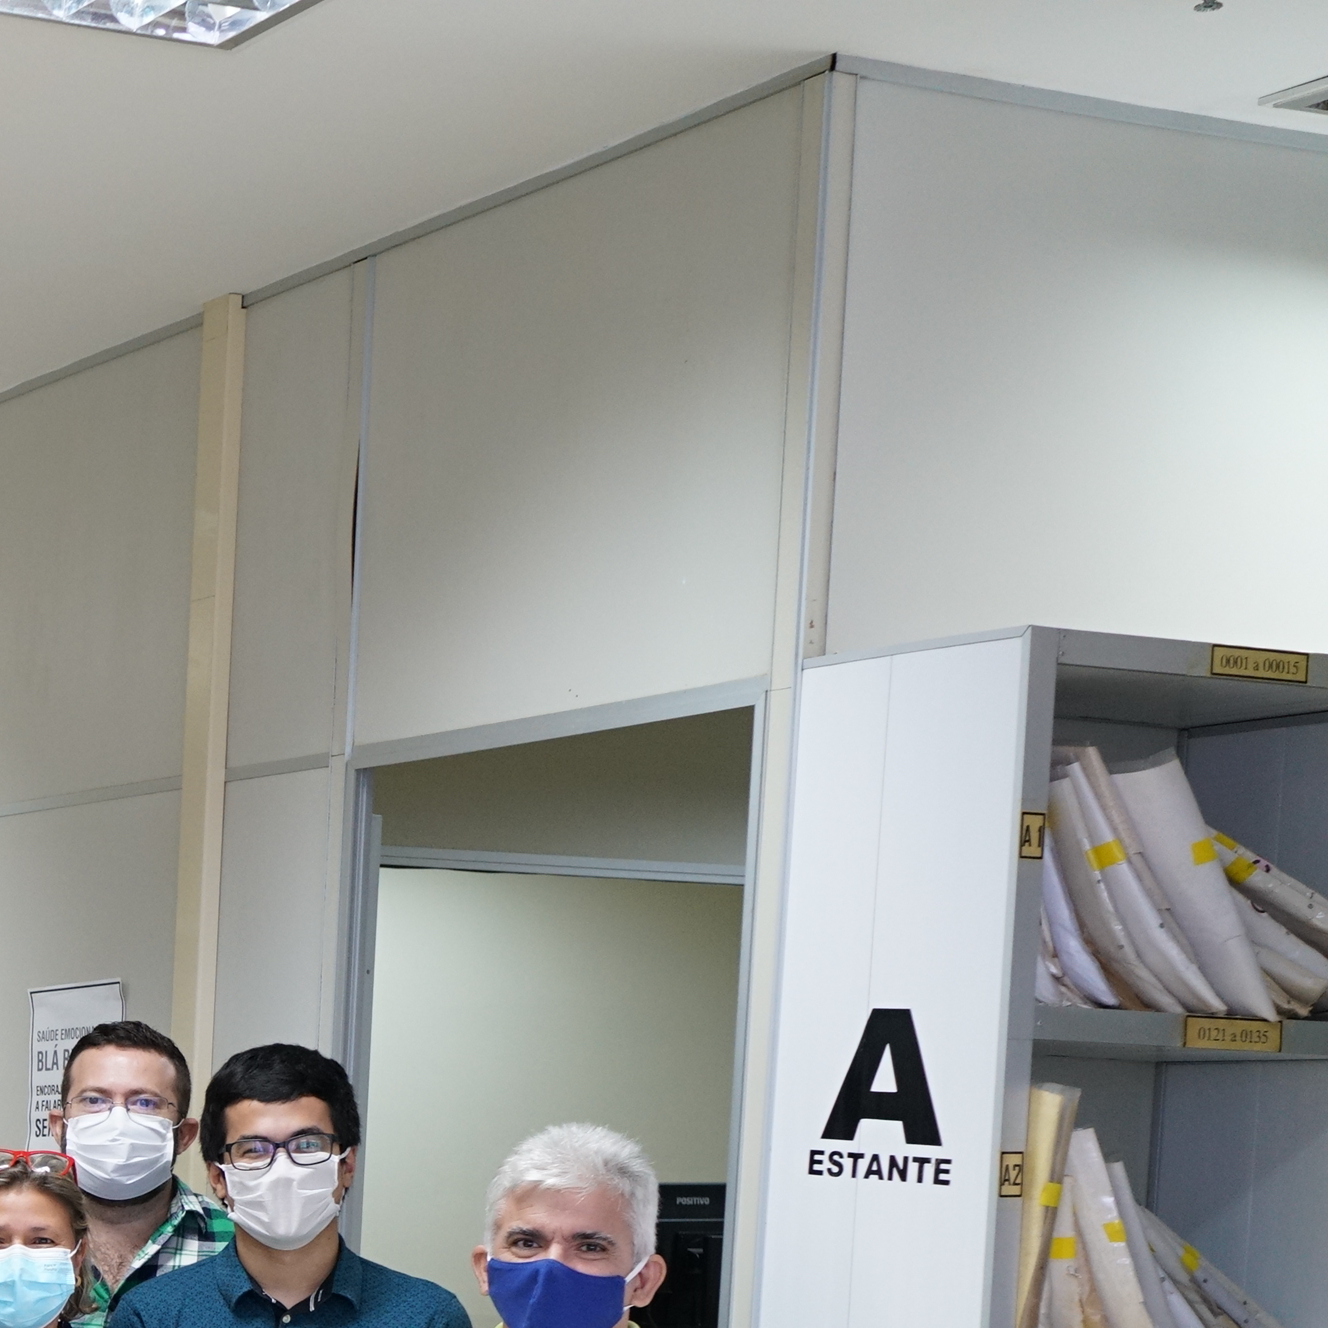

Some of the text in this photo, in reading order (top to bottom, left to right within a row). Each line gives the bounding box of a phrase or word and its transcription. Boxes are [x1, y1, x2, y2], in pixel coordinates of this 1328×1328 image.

[1220, 654, 1300, 675] 0001 a 00015
[36, 1025, 96, 1042] SAÚDE EMOCIONA
[1197, 1026, 1269, 1044] 0121 a 0135
[37, 1044, 60, 1072] BLÁ
[820, 1008, 942, 1146] A
[808, 1149, 953, 1186] ESTANTE
[1001, 1163, 1022, 1187] A2
[676, 1196, 710, 1206] POSITIVO
